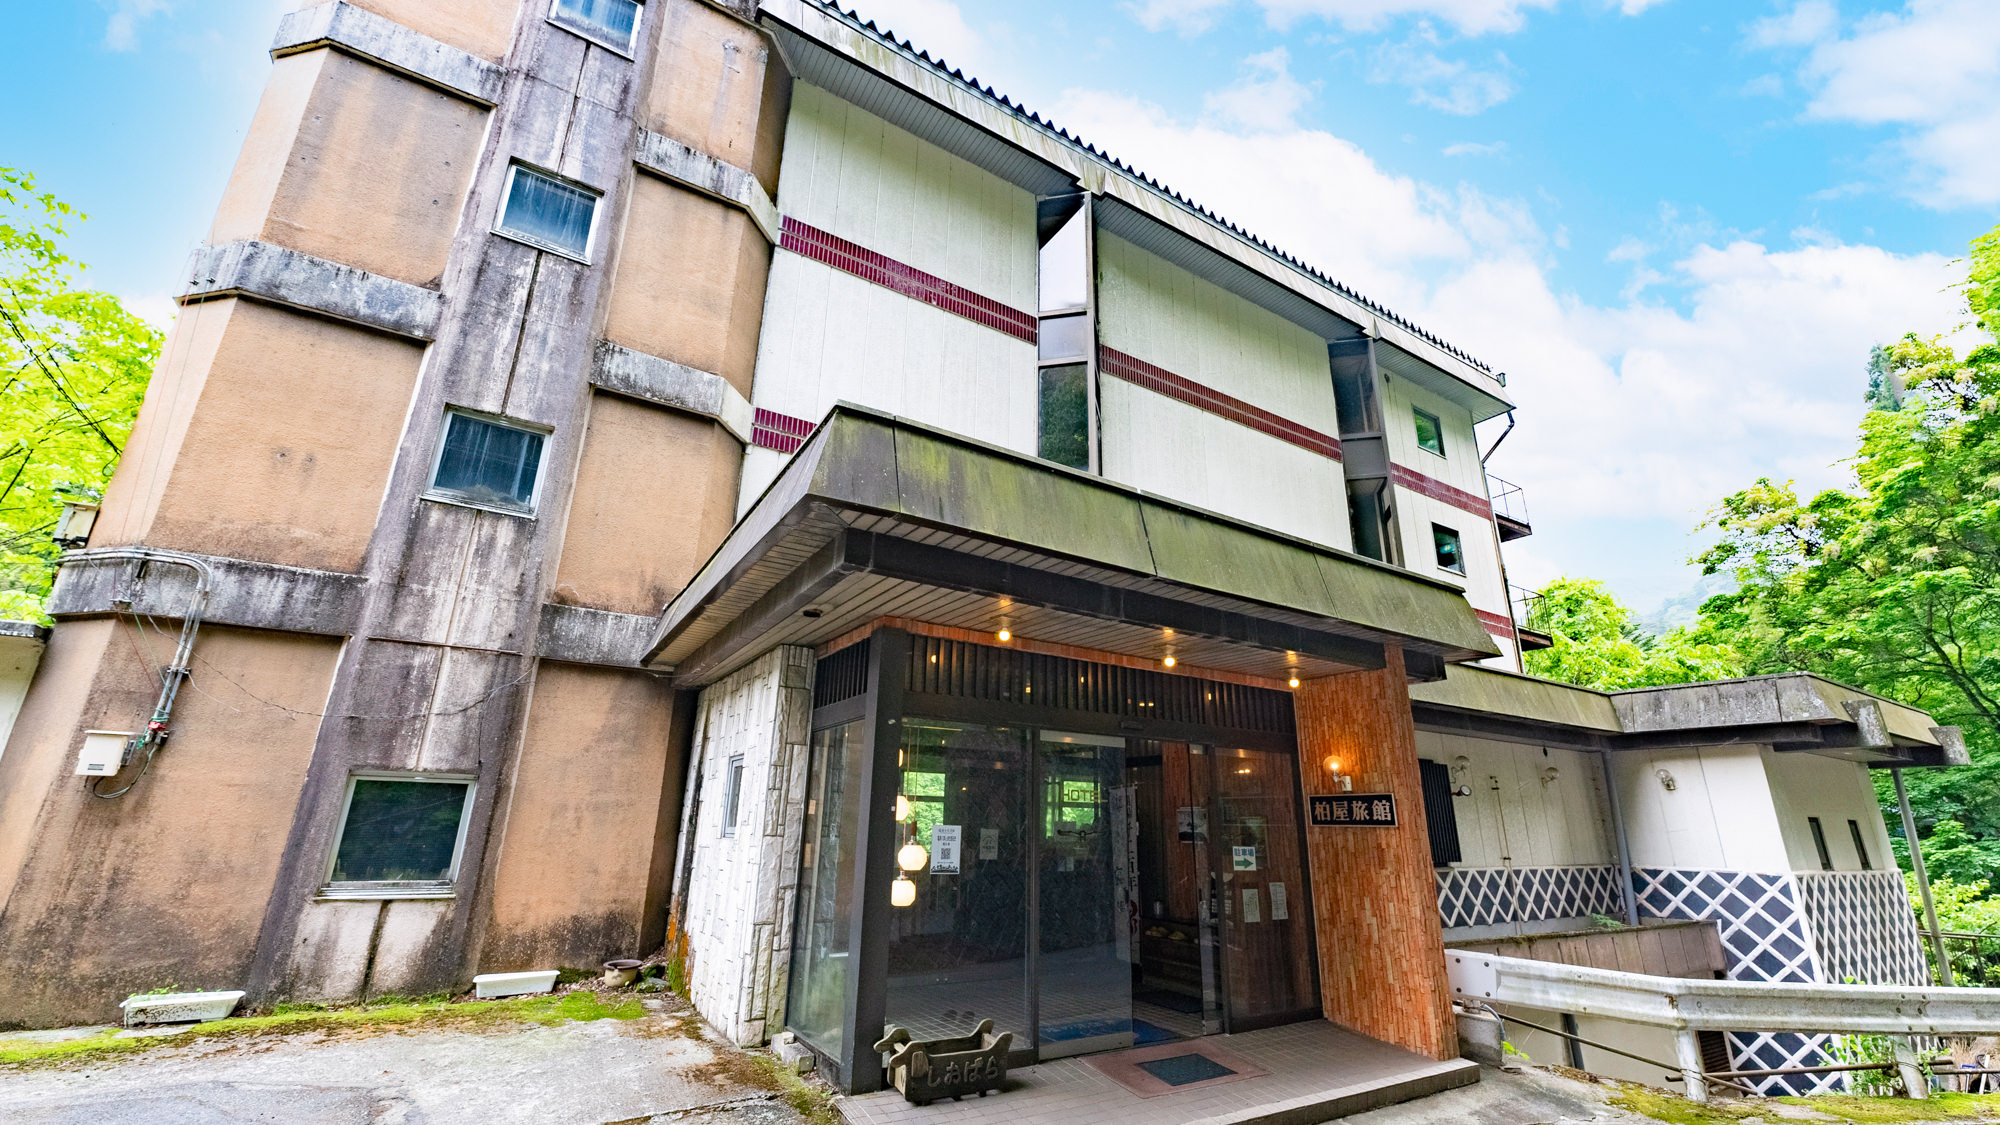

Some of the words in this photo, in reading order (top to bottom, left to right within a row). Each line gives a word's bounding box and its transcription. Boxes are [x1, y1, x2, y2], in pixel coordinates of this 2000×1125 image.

[1314, 800, 1391, 821] 柏屋旅館
[1234, 848, 1255, 857] 駐車場
[927, 1055, 999, 1088] しおばら
